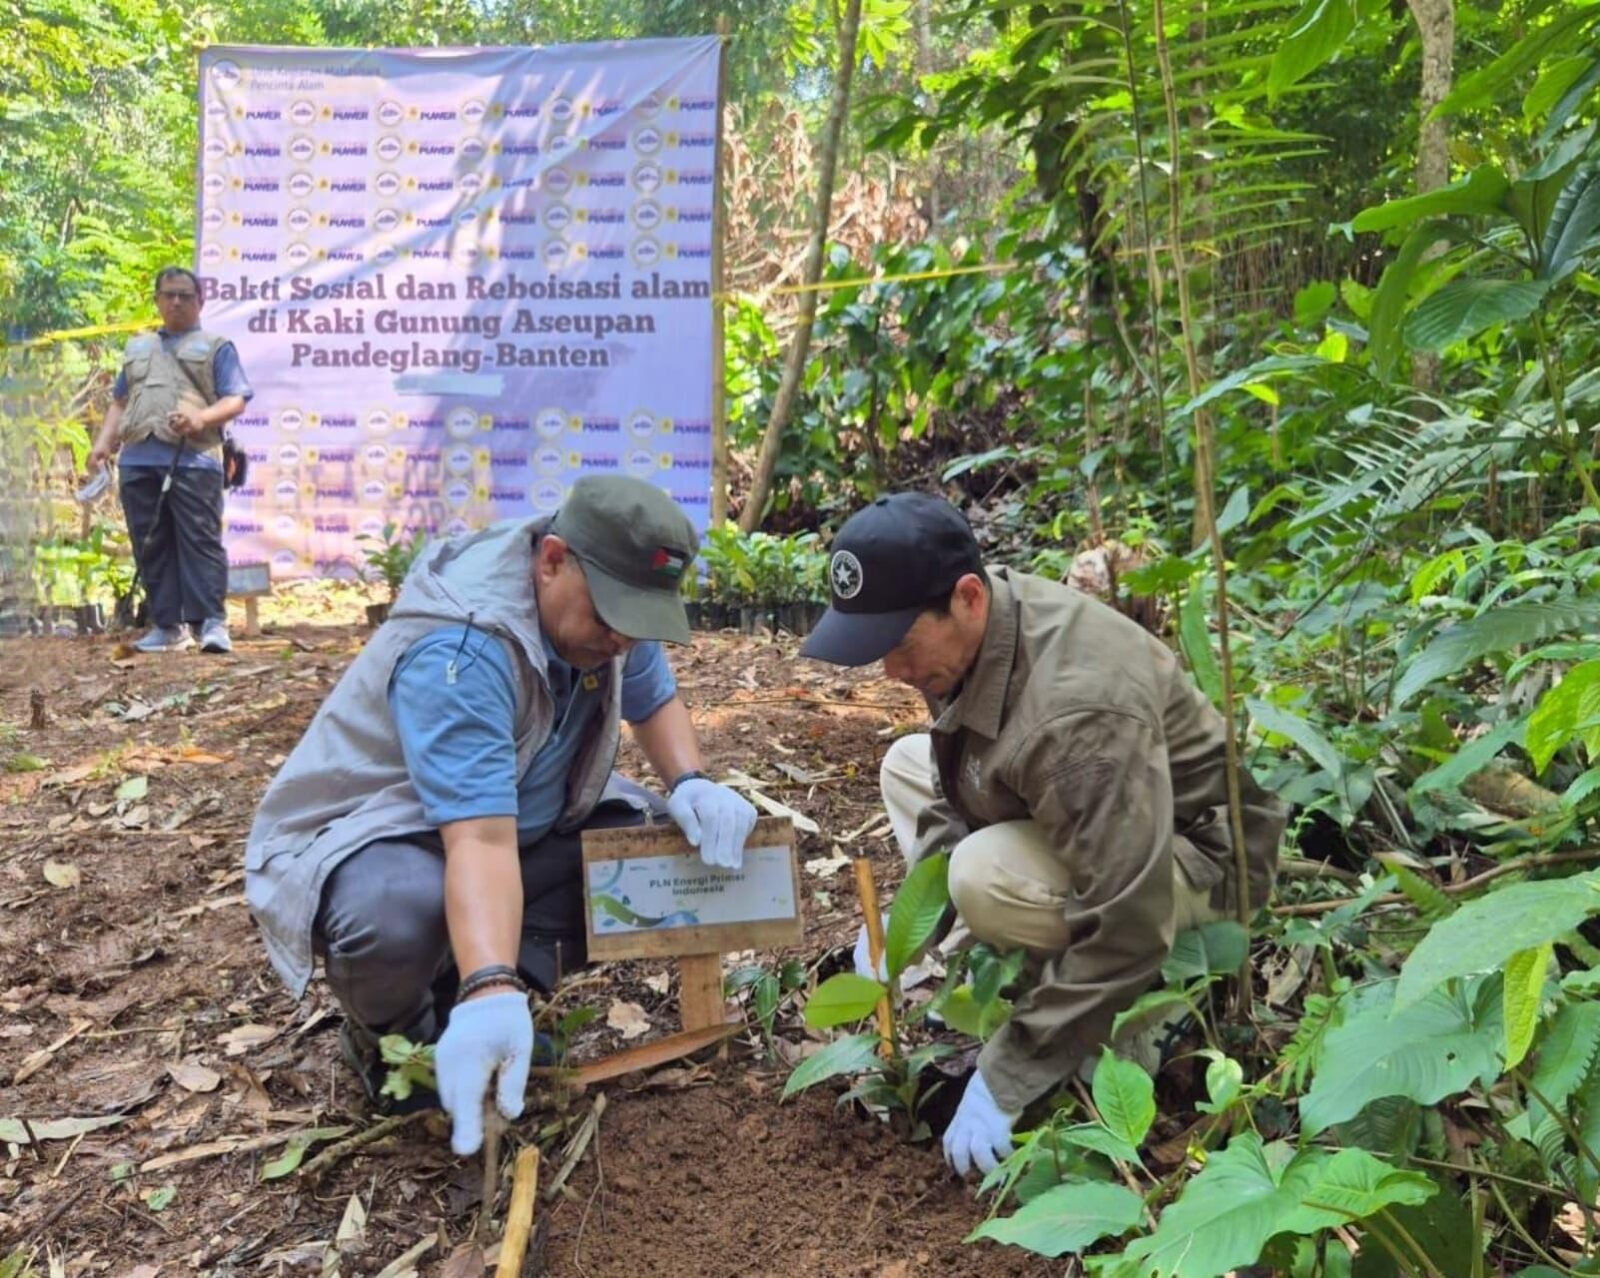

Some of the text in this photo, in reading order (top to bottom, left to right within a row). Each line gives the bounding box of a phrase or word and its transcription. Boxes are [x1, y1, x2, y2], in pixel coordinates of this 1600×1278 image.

[200, 273, 711, 301] Bakti Sosial dan Reboisasi alam
[248, 308, 656, 340] di Kaki Gunung Aseupan
[291, 341, 610, 373] Pandeglang-Banten
[649, 878, 672, 889] PLN
[673, 875, 709, 888] Energi
[672, 884, 726, 896] Indonesia
